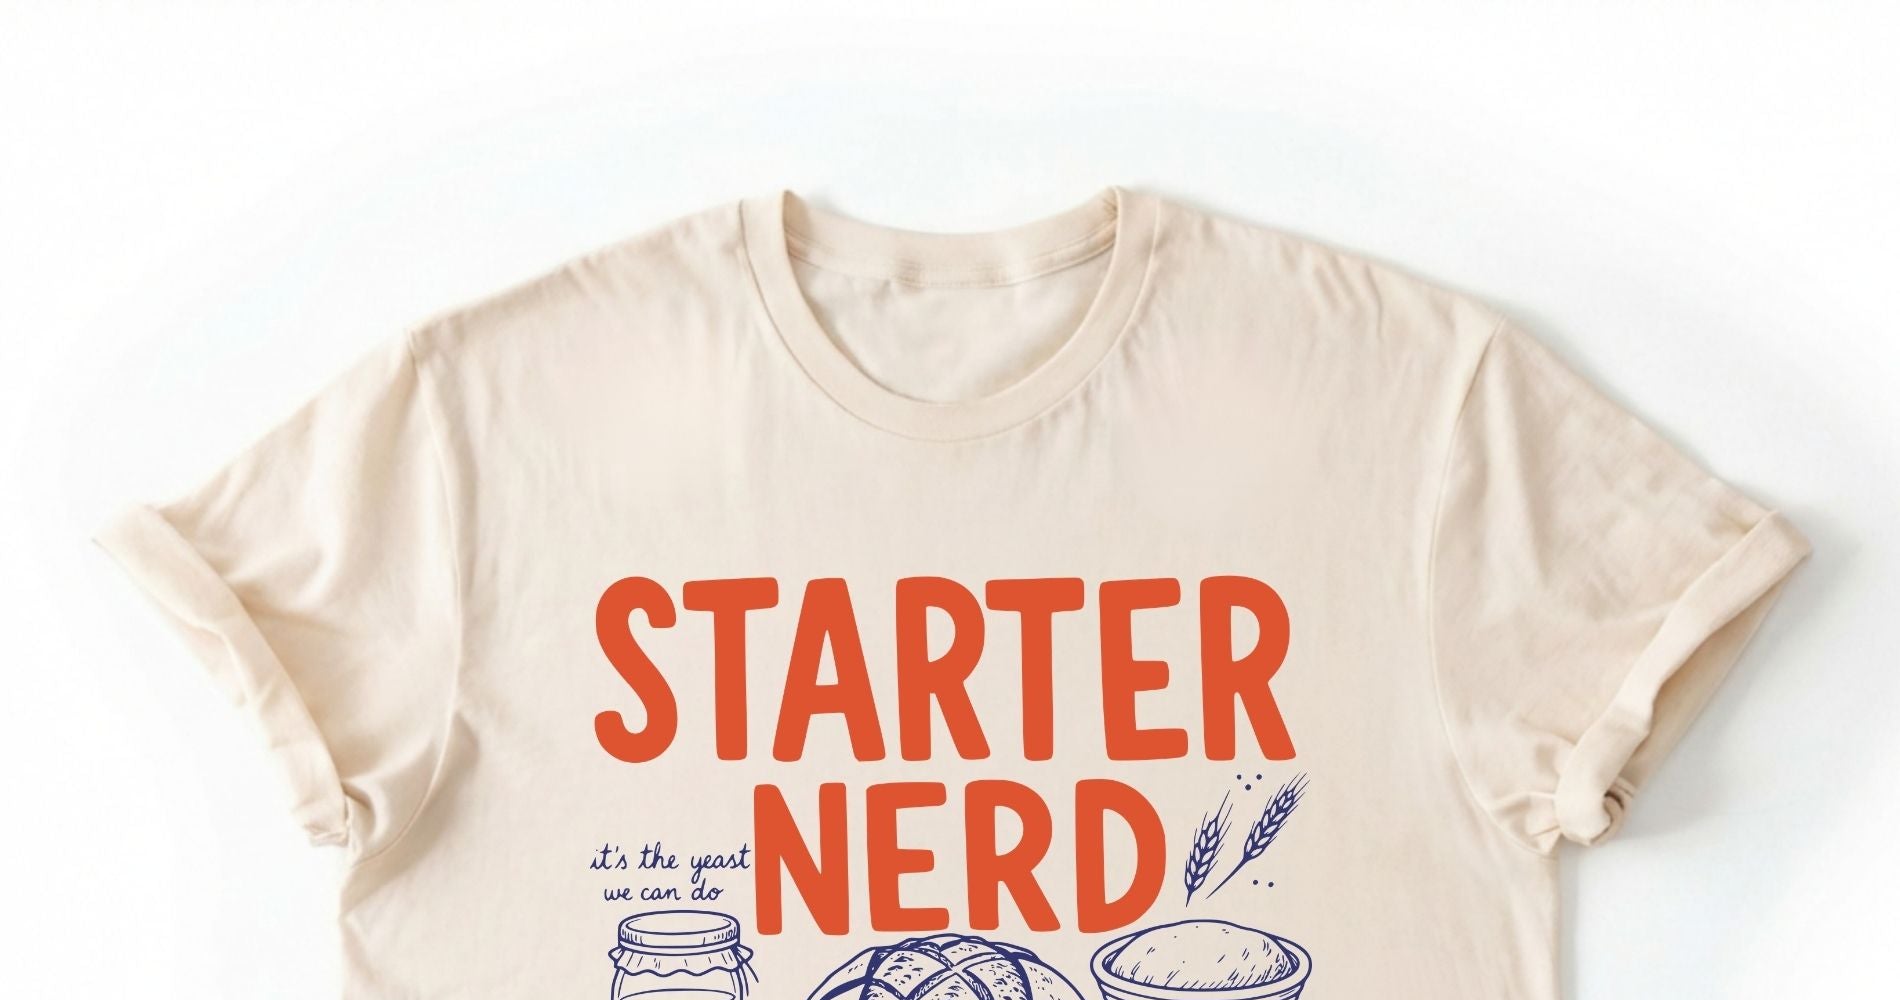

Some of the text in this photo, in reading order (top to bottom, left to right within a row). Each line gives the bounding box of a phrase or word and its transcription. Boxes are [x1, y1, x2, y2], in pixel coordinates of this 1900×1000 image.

[594, 574, 1297, 763] STARTER
[589, 841, 752, 884] it's the yeast
[603, 877, 724, 902] we can do
[754, 778, 1167, 936] NERD
